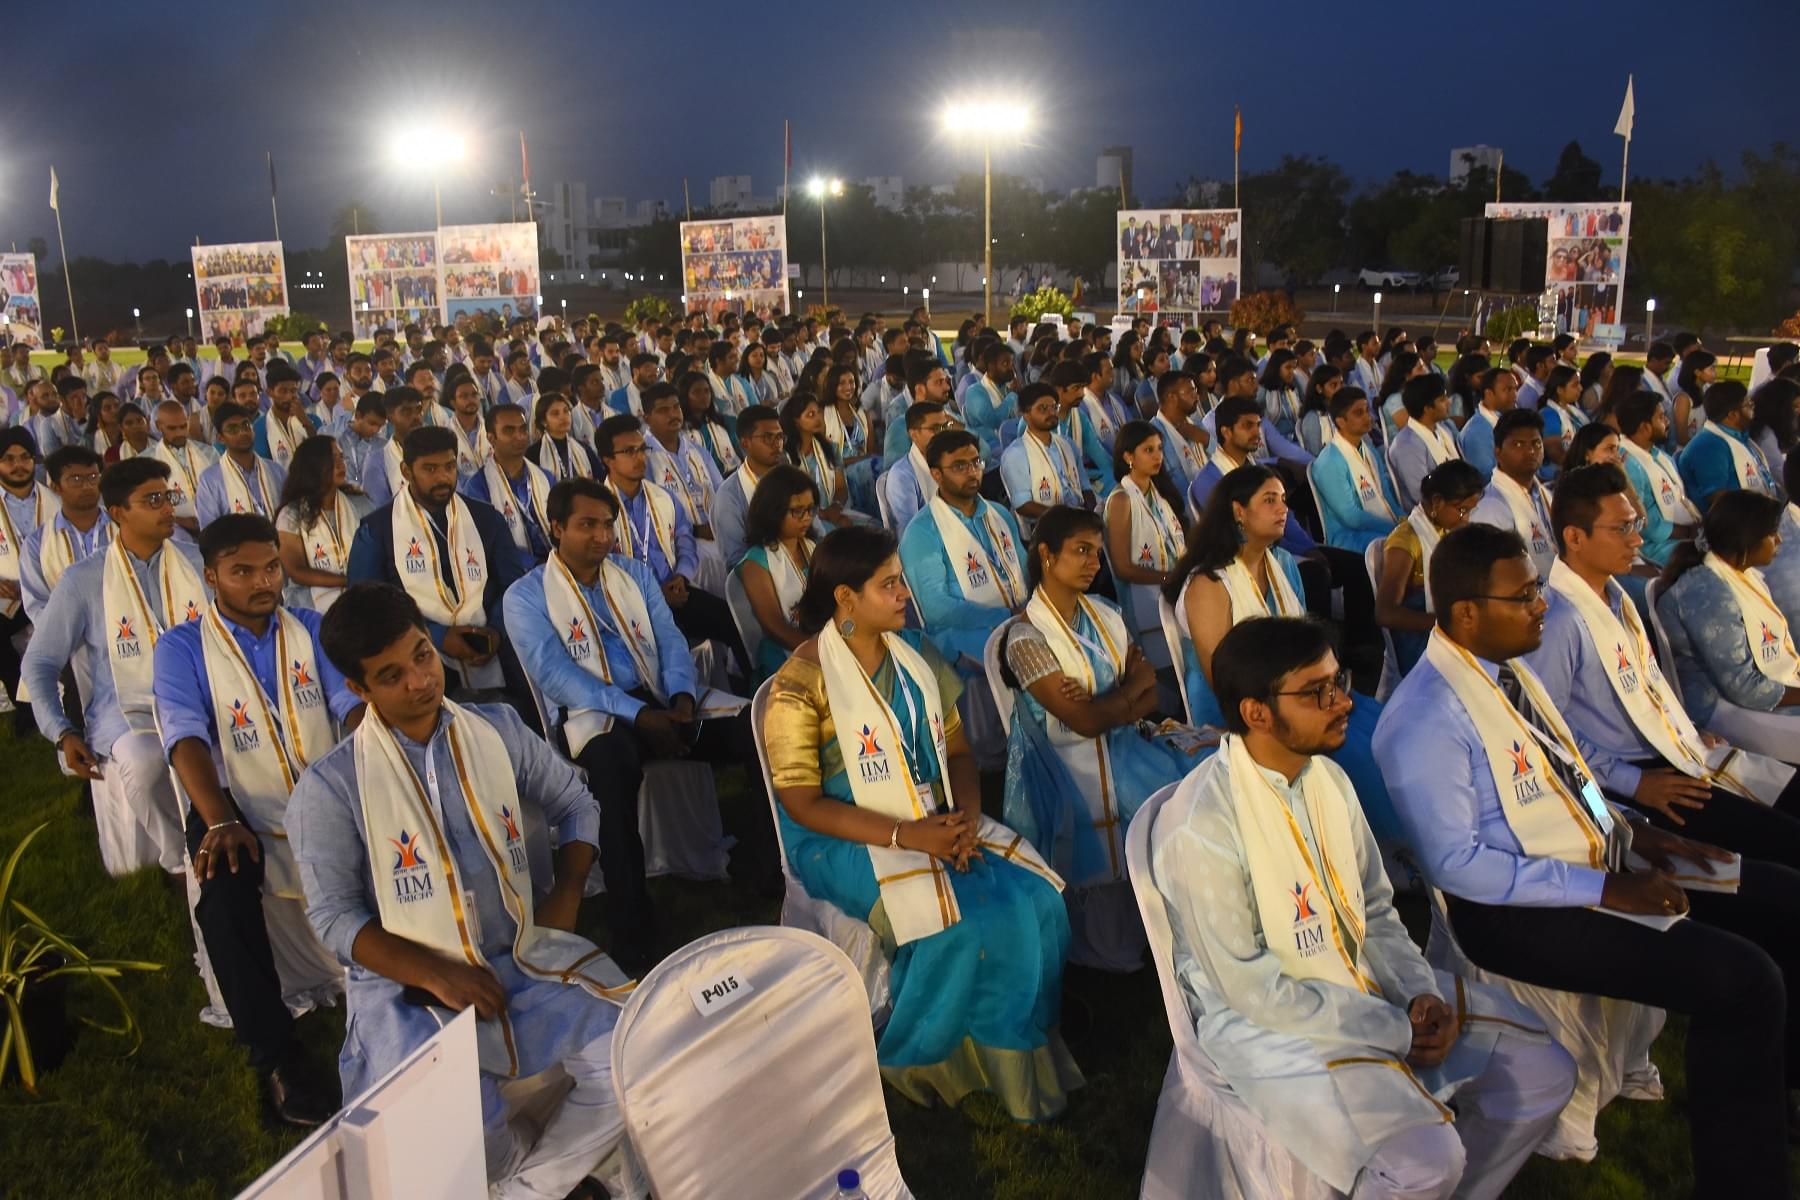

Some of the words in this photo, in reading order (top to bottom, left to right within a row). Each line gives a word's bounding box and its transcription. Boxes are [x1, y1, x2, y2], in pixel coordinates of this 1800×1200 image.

[406, 559, 426, 569] IIM
[968, 571, 988, 585] IIM
[117, 641, 140, 656] IIM
[569, 642, 591, 657] IIM
[1762, 644, 1780, 659] IIM
[1619, 672, 1638, 690] IIM
[296, 688, 321, 705] IIM
[232, 729, 259, 748] IIM
[860, 759, 889, 777] IIM
[1514, 776, 1540, 801] IIM
[394, 872, 433, 897] IIM
[398, 891, 433, 904] TRICHY
[1295, 924, 1324, 950] IIM
[701, 975, 739, 1004] P-015
